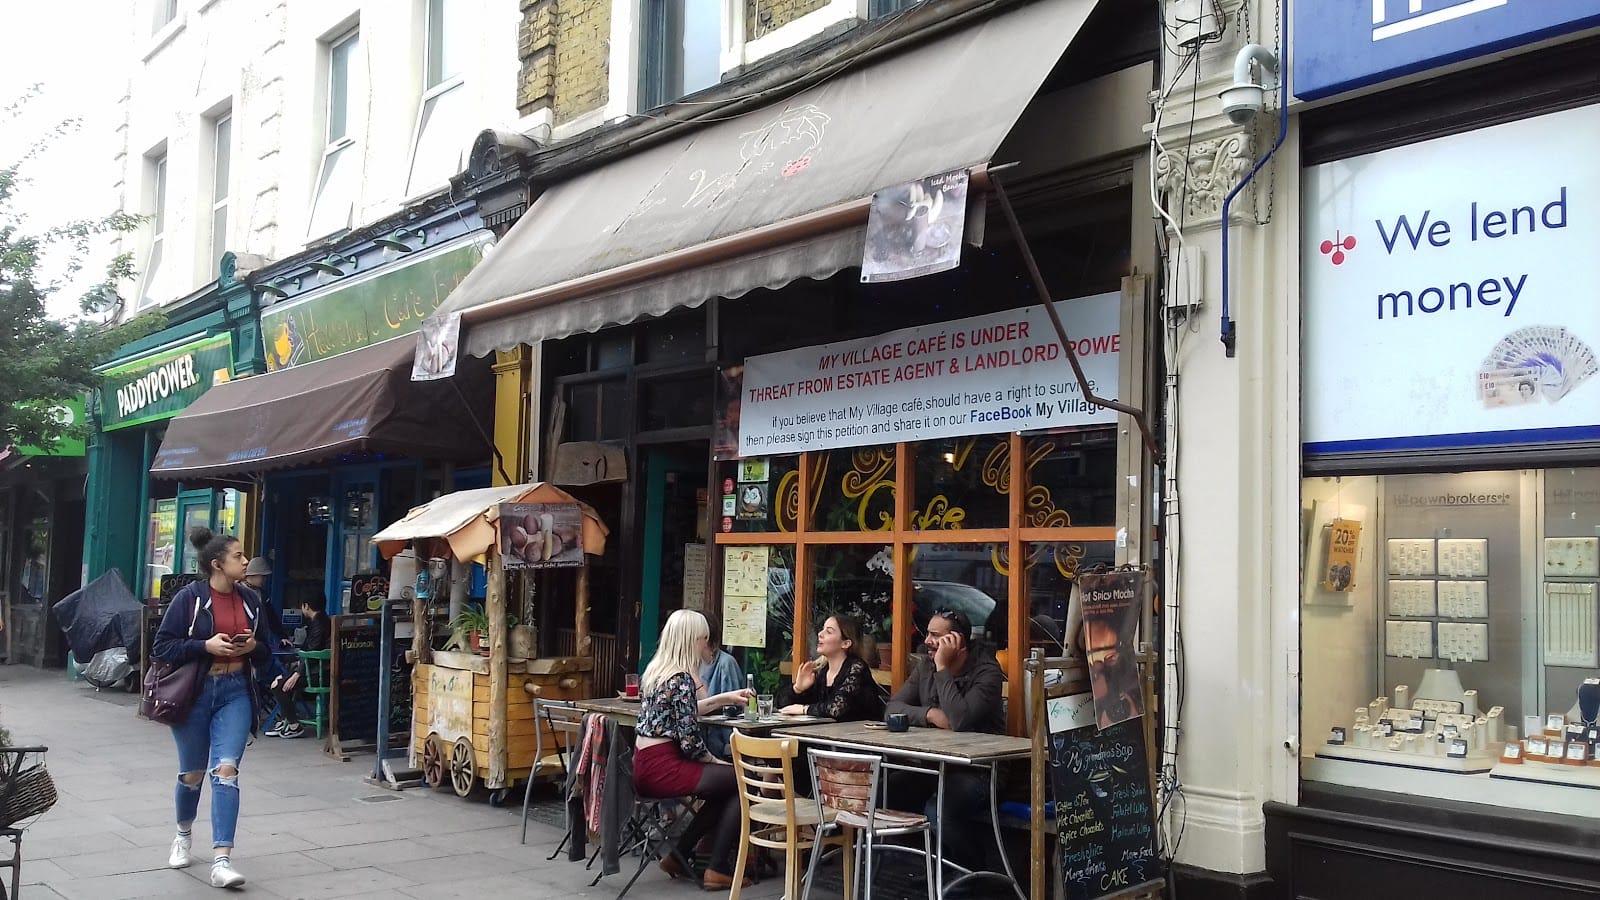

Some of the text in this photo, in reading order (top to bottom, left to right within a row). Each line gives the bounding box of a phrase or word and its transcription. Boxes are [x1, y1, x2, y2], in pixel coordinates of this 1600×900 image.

[1375, 186, 1567, 255] We lend
[1378, 274, 1528, 320] money
[819, 322, 1029, 370] MY VILLAGE CAFÉ IS UNDER
[750, 383, 795, 403] THREAT
[797, 376, 833, 396] FROM
[837, 368, 890, 390] ESTATE
[894, 360, 944, 383] AGENT
[950, 358, 960, 374] &
[965, 343, 1059, 373] LANDLORD
[746, 435, 764, 447] then
[766, 431, 796, 447] please
[797, 431, 815, 444] sign
[817, 427, 833, 440] this
[835, 421, 868, 440] petition
[871, 420, 890, 434] and
[893, 417, 921, 431] share
[924, 415, 931, 429] it
[933, 416, 946, 427] on
[949, 413, 967, 426] our
[970, 405, 1032, 423] FaceBook
[1036, 402, 1054, 419] My
[779, 418, 794, 430] you
[796, 412, 826, 425] believe
[829, 408, 846, 421] that
[849, 406, 863, 421] My
[866, 402, 898, 418] Village
[964, 391, 991, 405] have
[995, 390, 1003, 402] a
[1007, 385, 1031, 403] right
[1035, 383, 1046, 397] to
[1049, 379, 1099, 396] survie,
[1092, 590, 1112, 602] Spicy
[1113, 588, 1135, 600] Mocha
[1100, 867, 1129, 891] CAKE
